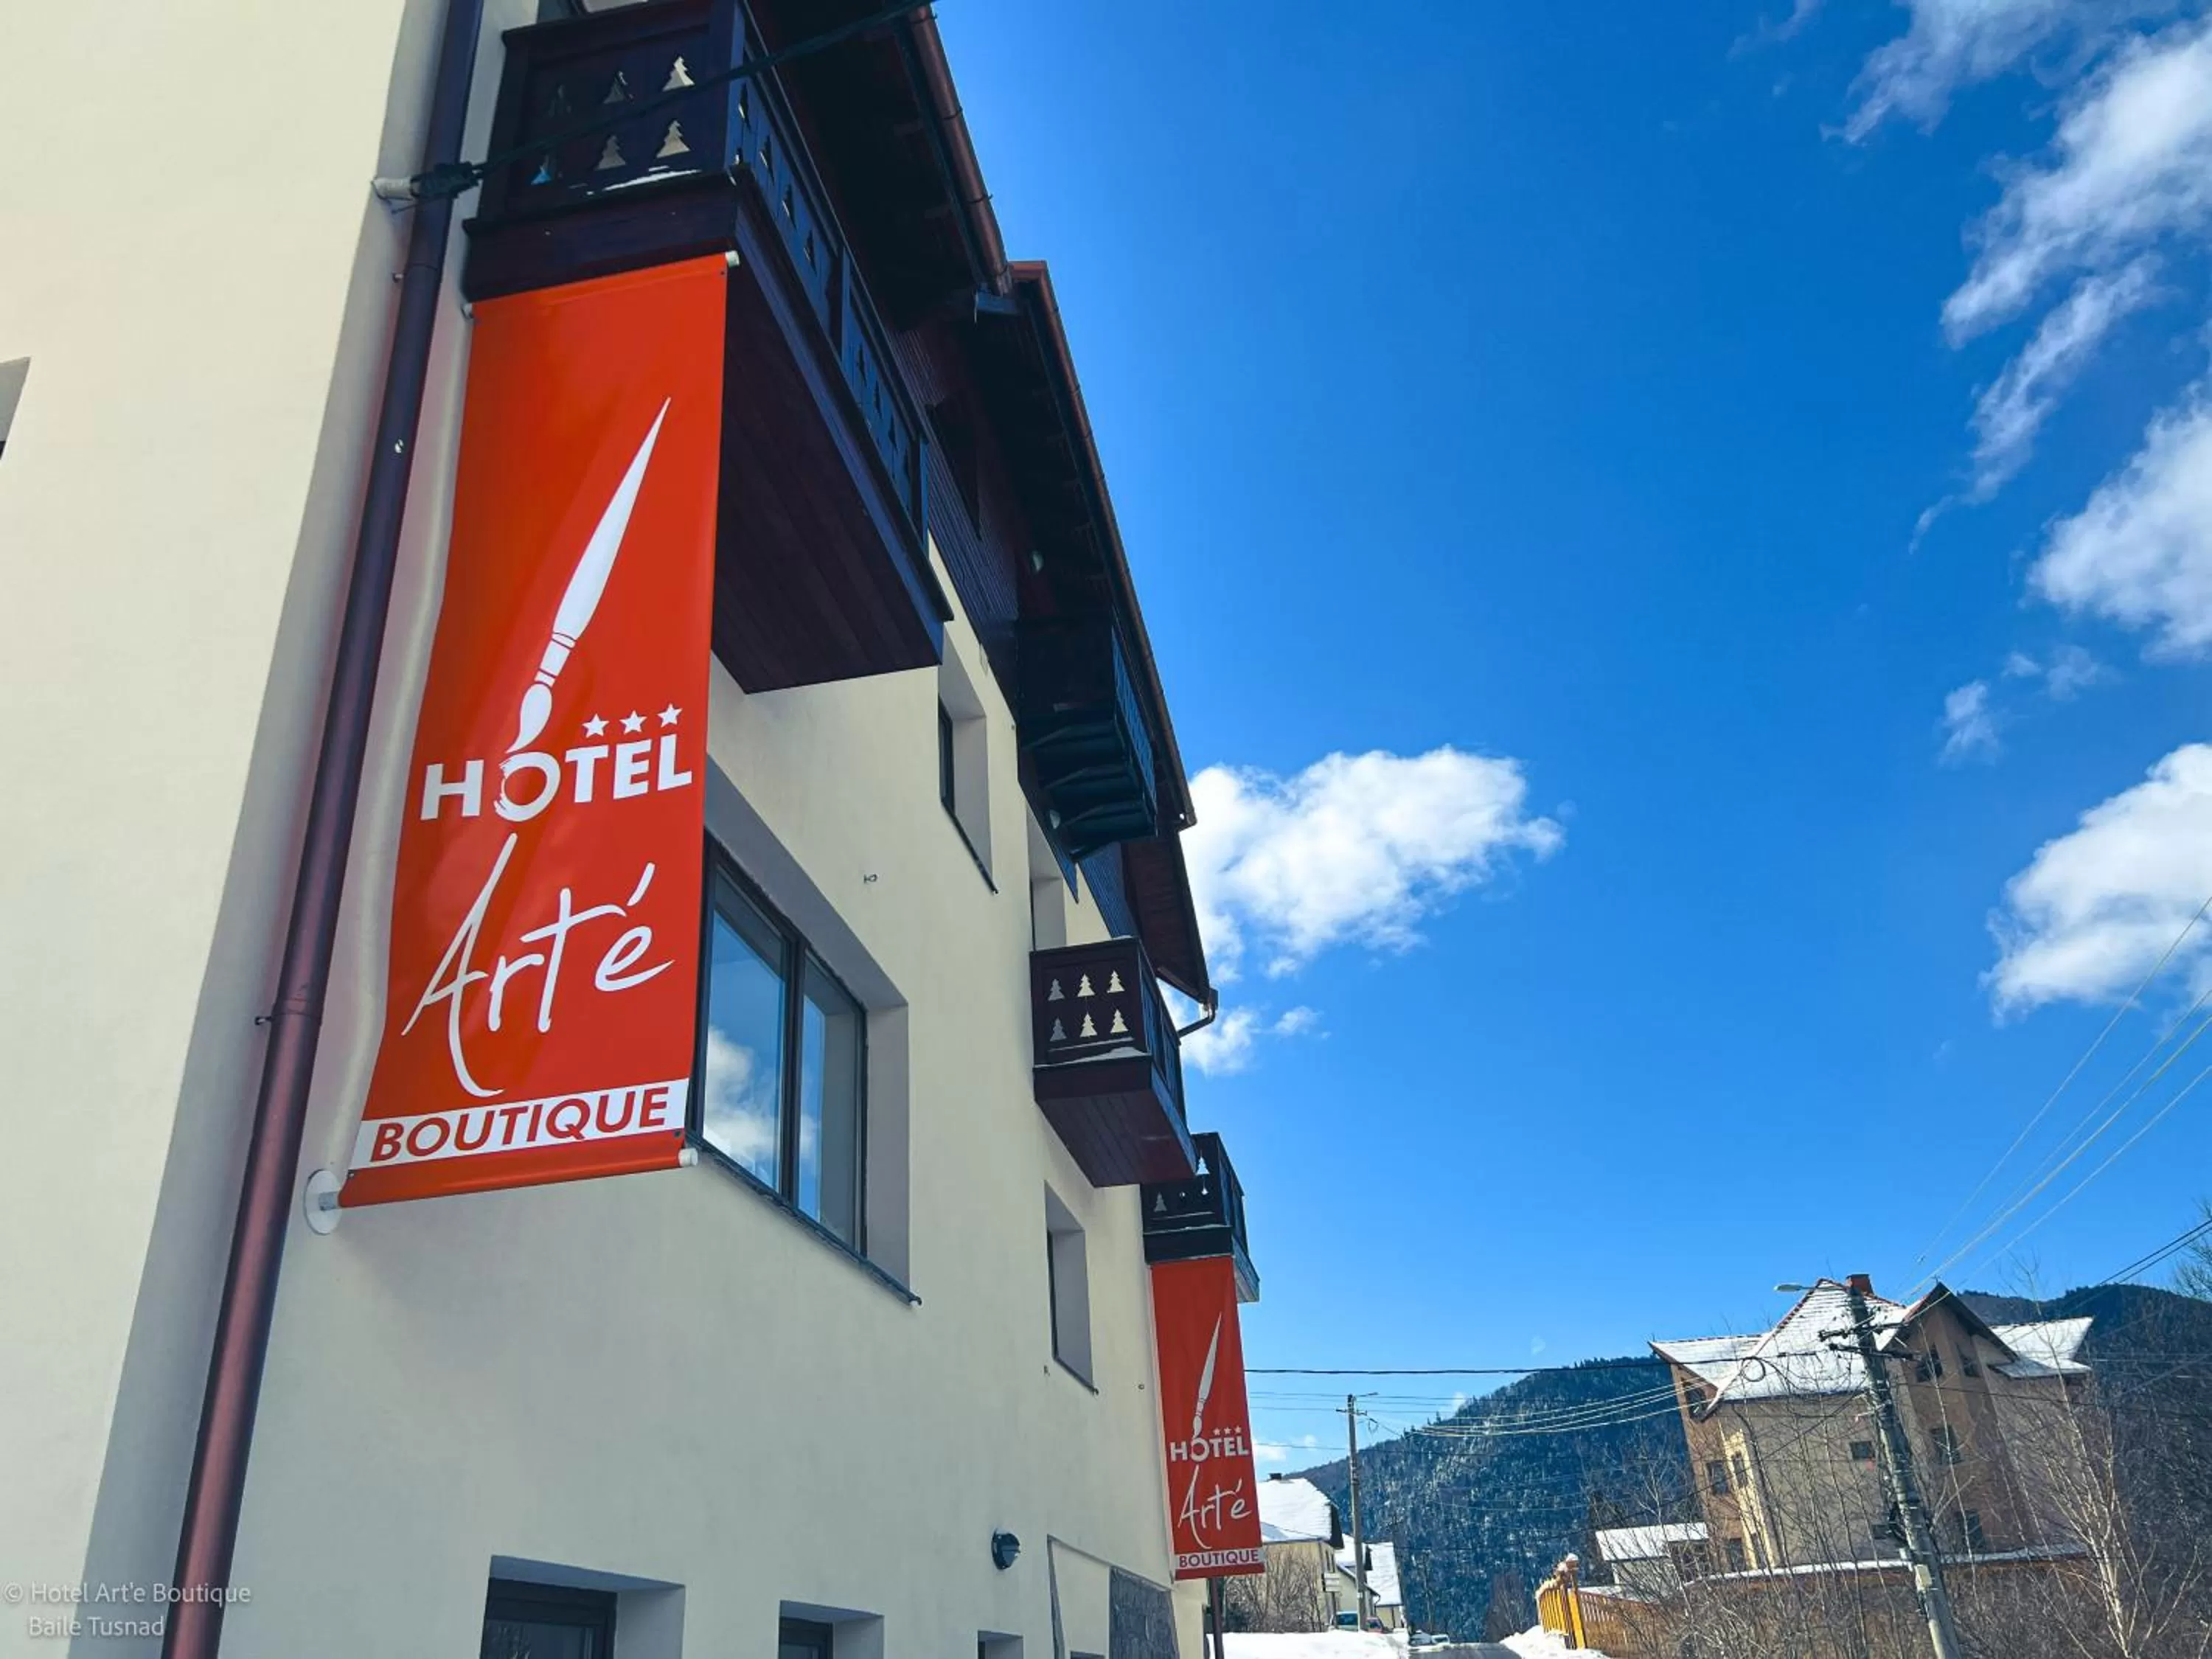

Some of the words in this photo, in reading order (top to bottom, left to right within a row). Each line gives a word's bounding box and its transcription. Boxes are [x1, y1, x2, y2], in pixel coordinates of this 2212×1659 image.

[420, 734, 692, 821] HOTEL
[369, 1087, 669, 1164] BOUTIQUE
[1170, 1436, 1249, 1462] HOTEL
[1179, 1549, 1259, 1568] BOUTIQUE
